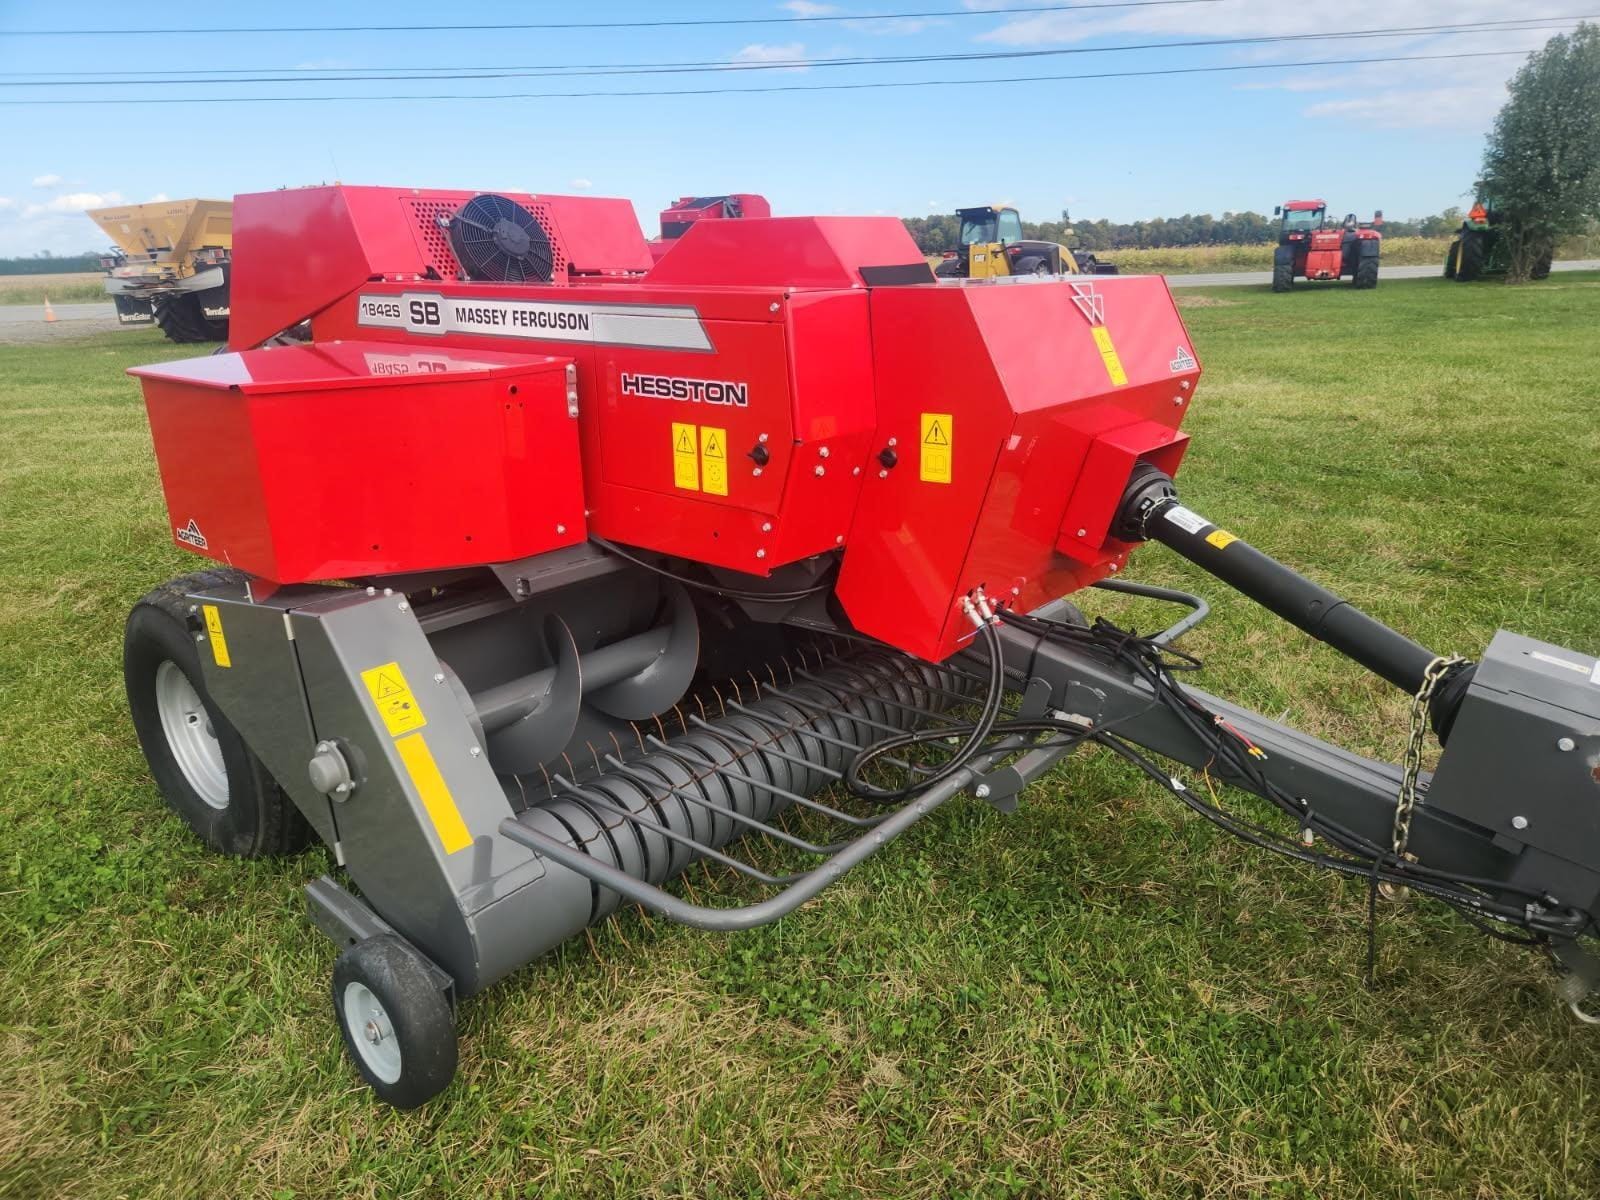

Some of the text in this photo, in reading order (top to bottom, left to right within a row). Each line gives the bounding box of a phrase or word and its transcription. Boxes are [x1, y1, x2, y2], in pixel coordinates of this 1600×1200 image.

[362, 301, 590, 331] 1842S SB MASSEY FERGUSON
[622, 373, 748, 407] HESSTON
